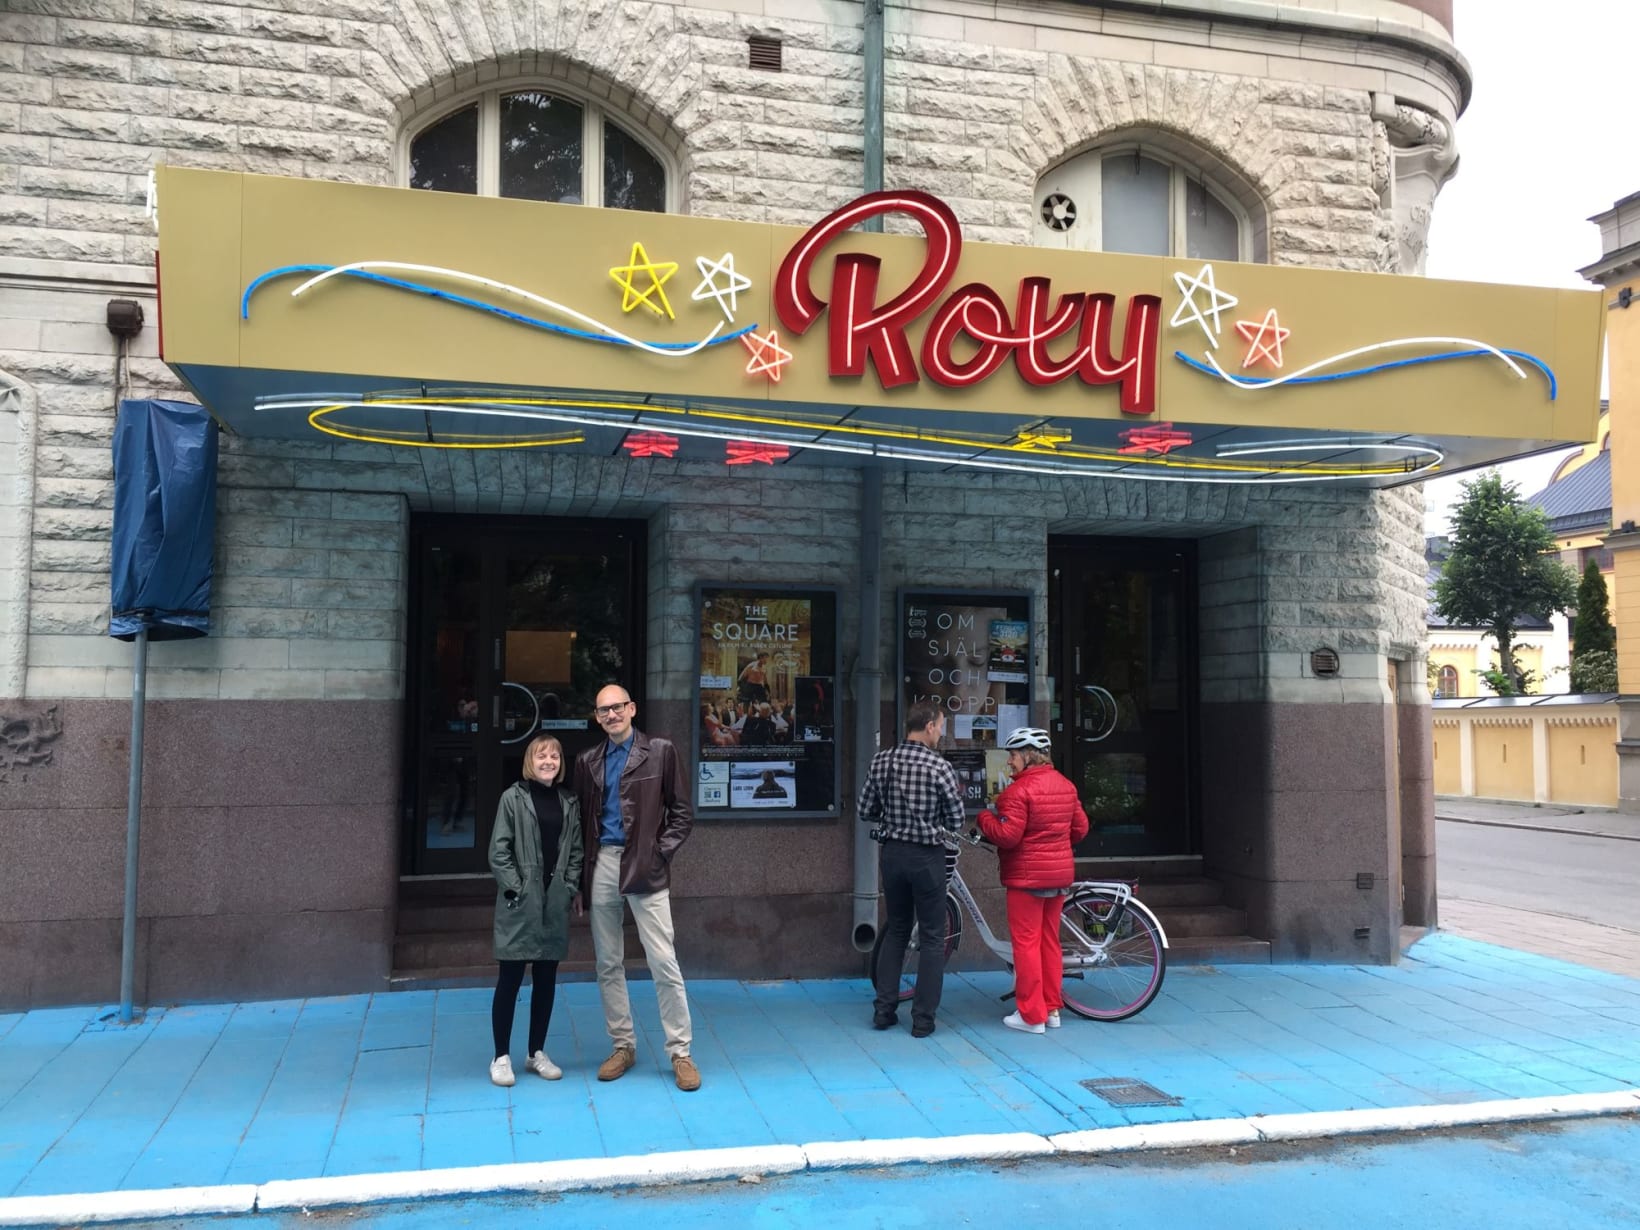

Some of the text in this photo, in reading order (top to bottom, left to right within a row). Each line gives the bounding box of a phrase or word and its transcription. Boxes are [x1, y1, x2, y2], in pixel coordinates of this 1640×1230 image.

[773, 190, 1162, 414] Roxy
[745, 605, 768, 616] THE
[937, 613, 974, 631] OM
[713, 623, 799, 641] SQUARE
[928, 637, 983, 658] SJÄL
[928, 668, 980, 686] OCH
